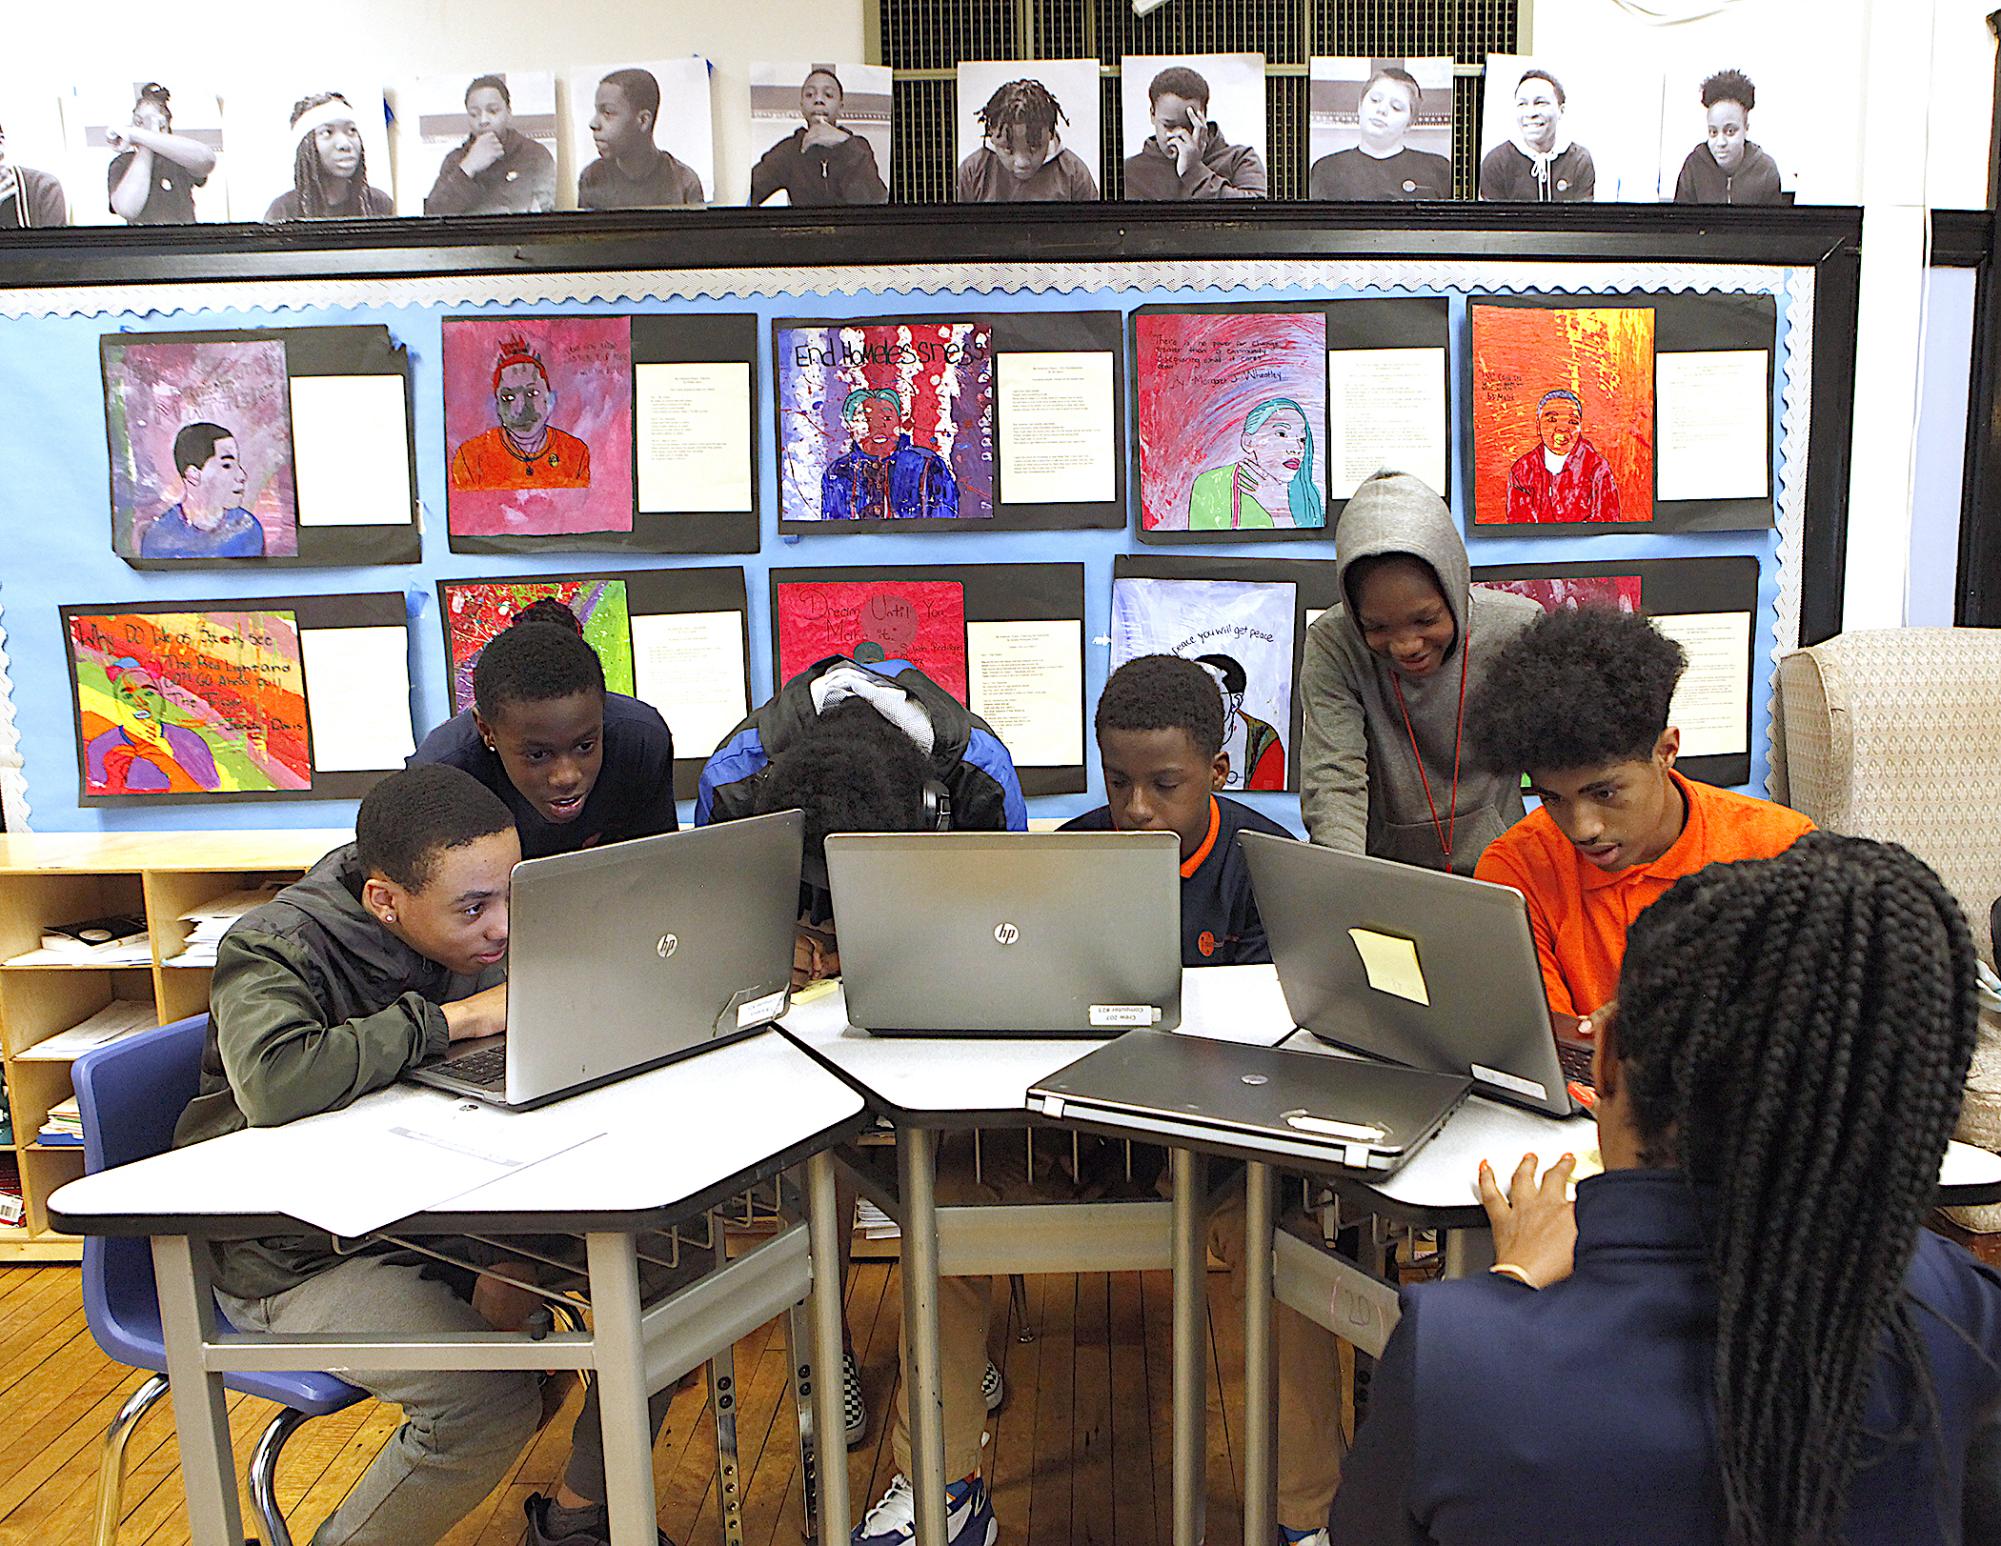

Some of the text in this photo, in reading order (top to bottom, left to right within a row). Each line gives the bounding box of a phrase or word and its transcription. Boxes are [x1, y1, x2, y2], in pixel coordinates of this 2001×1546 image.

[795, 338, 836, 367] End
[799, 588, 861, 622] Dream
[871, 594, 910, 620] Until
[1197, 630, 1215, 644] you
[1214, 624, 1232, 636] will
[1233, 626, 1248, 640] get
[1249, 629, 1274, 643] peace
[660, 933, 676, 958] hp
[999, 923, 1016, 945] hp
